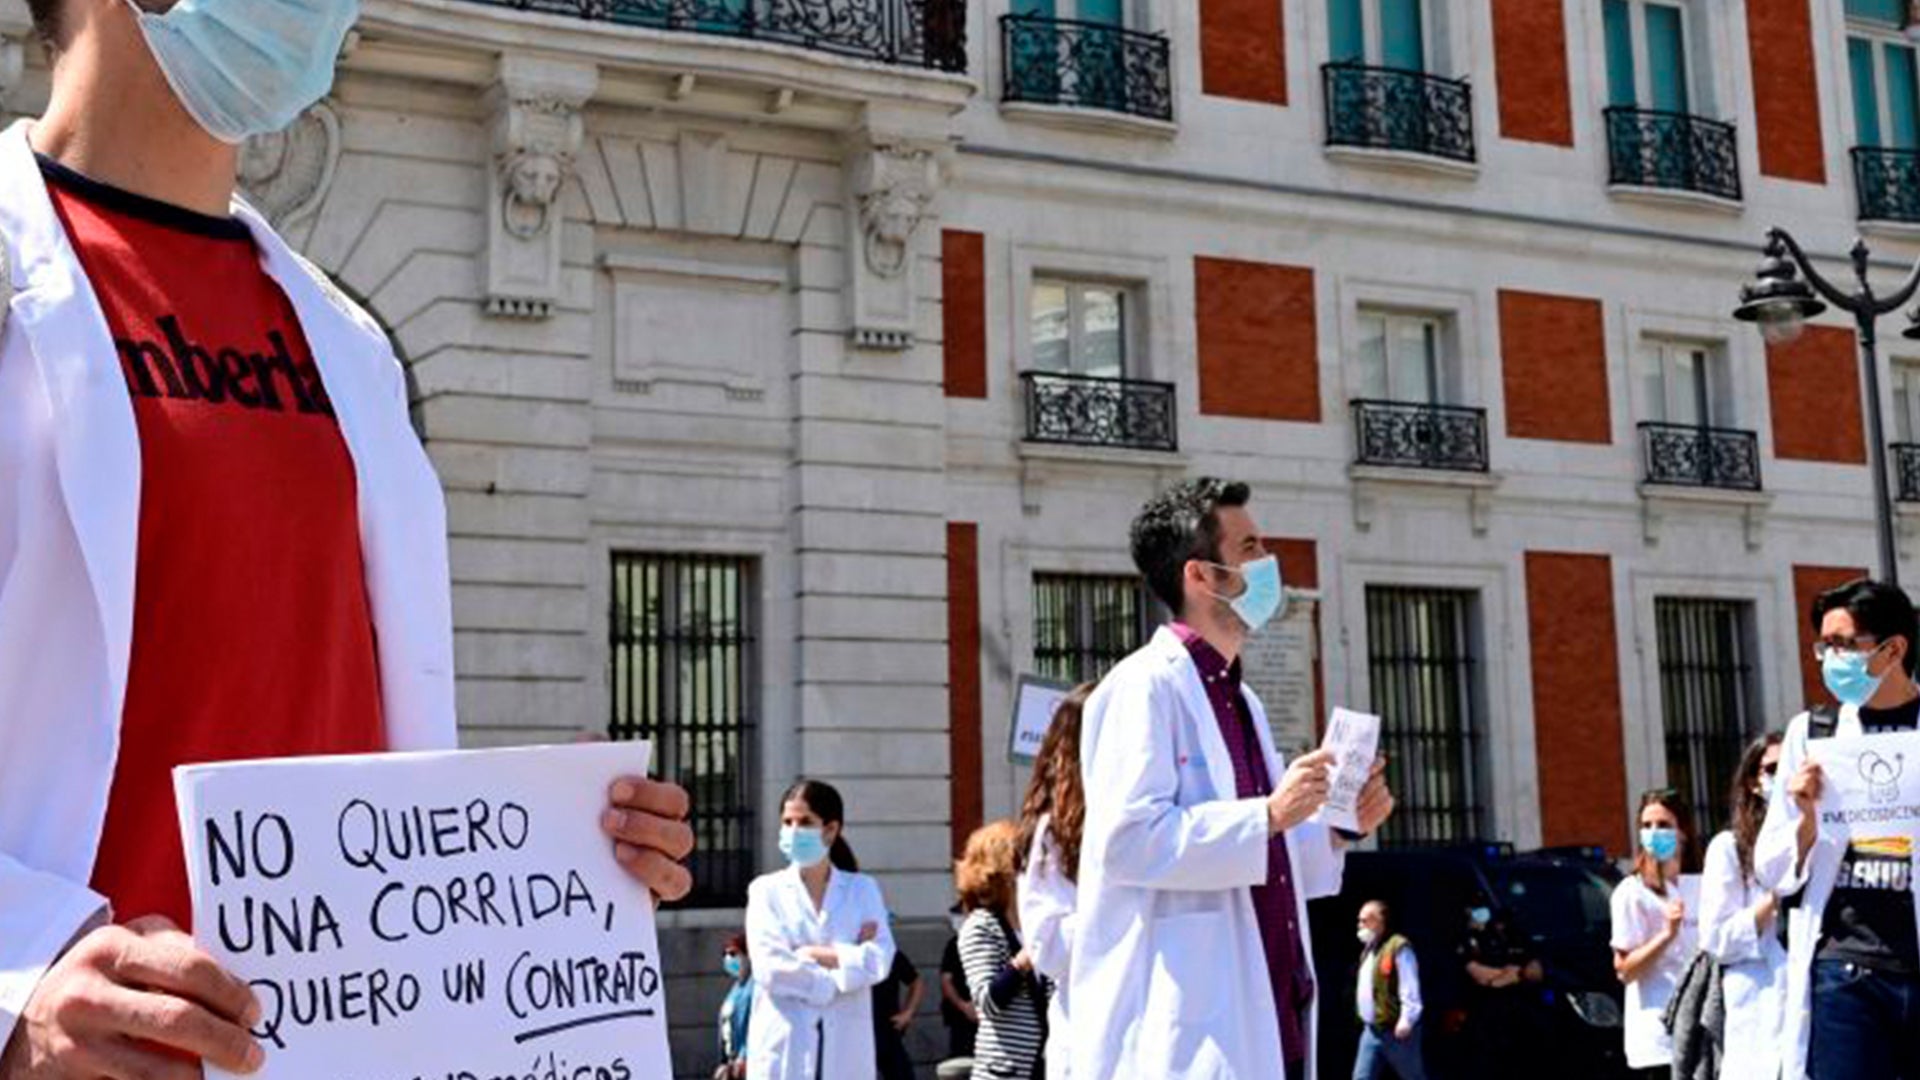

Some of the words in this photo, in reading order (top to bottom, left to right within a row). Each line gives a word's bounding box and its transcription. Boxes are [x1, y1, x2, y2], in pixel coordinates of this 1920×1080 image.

[205, 810, 294, 886] NO
[337, 798, 528, 874] QUIERO
[218, 895, 343, 956] UNA
[369, 869, 614, 942] CORRIDA,
[248, 968, 421, 1049] QUIERO
[443, 958, 485, 1004] UN
[505, 951, 658, 1019] CONTRATO
